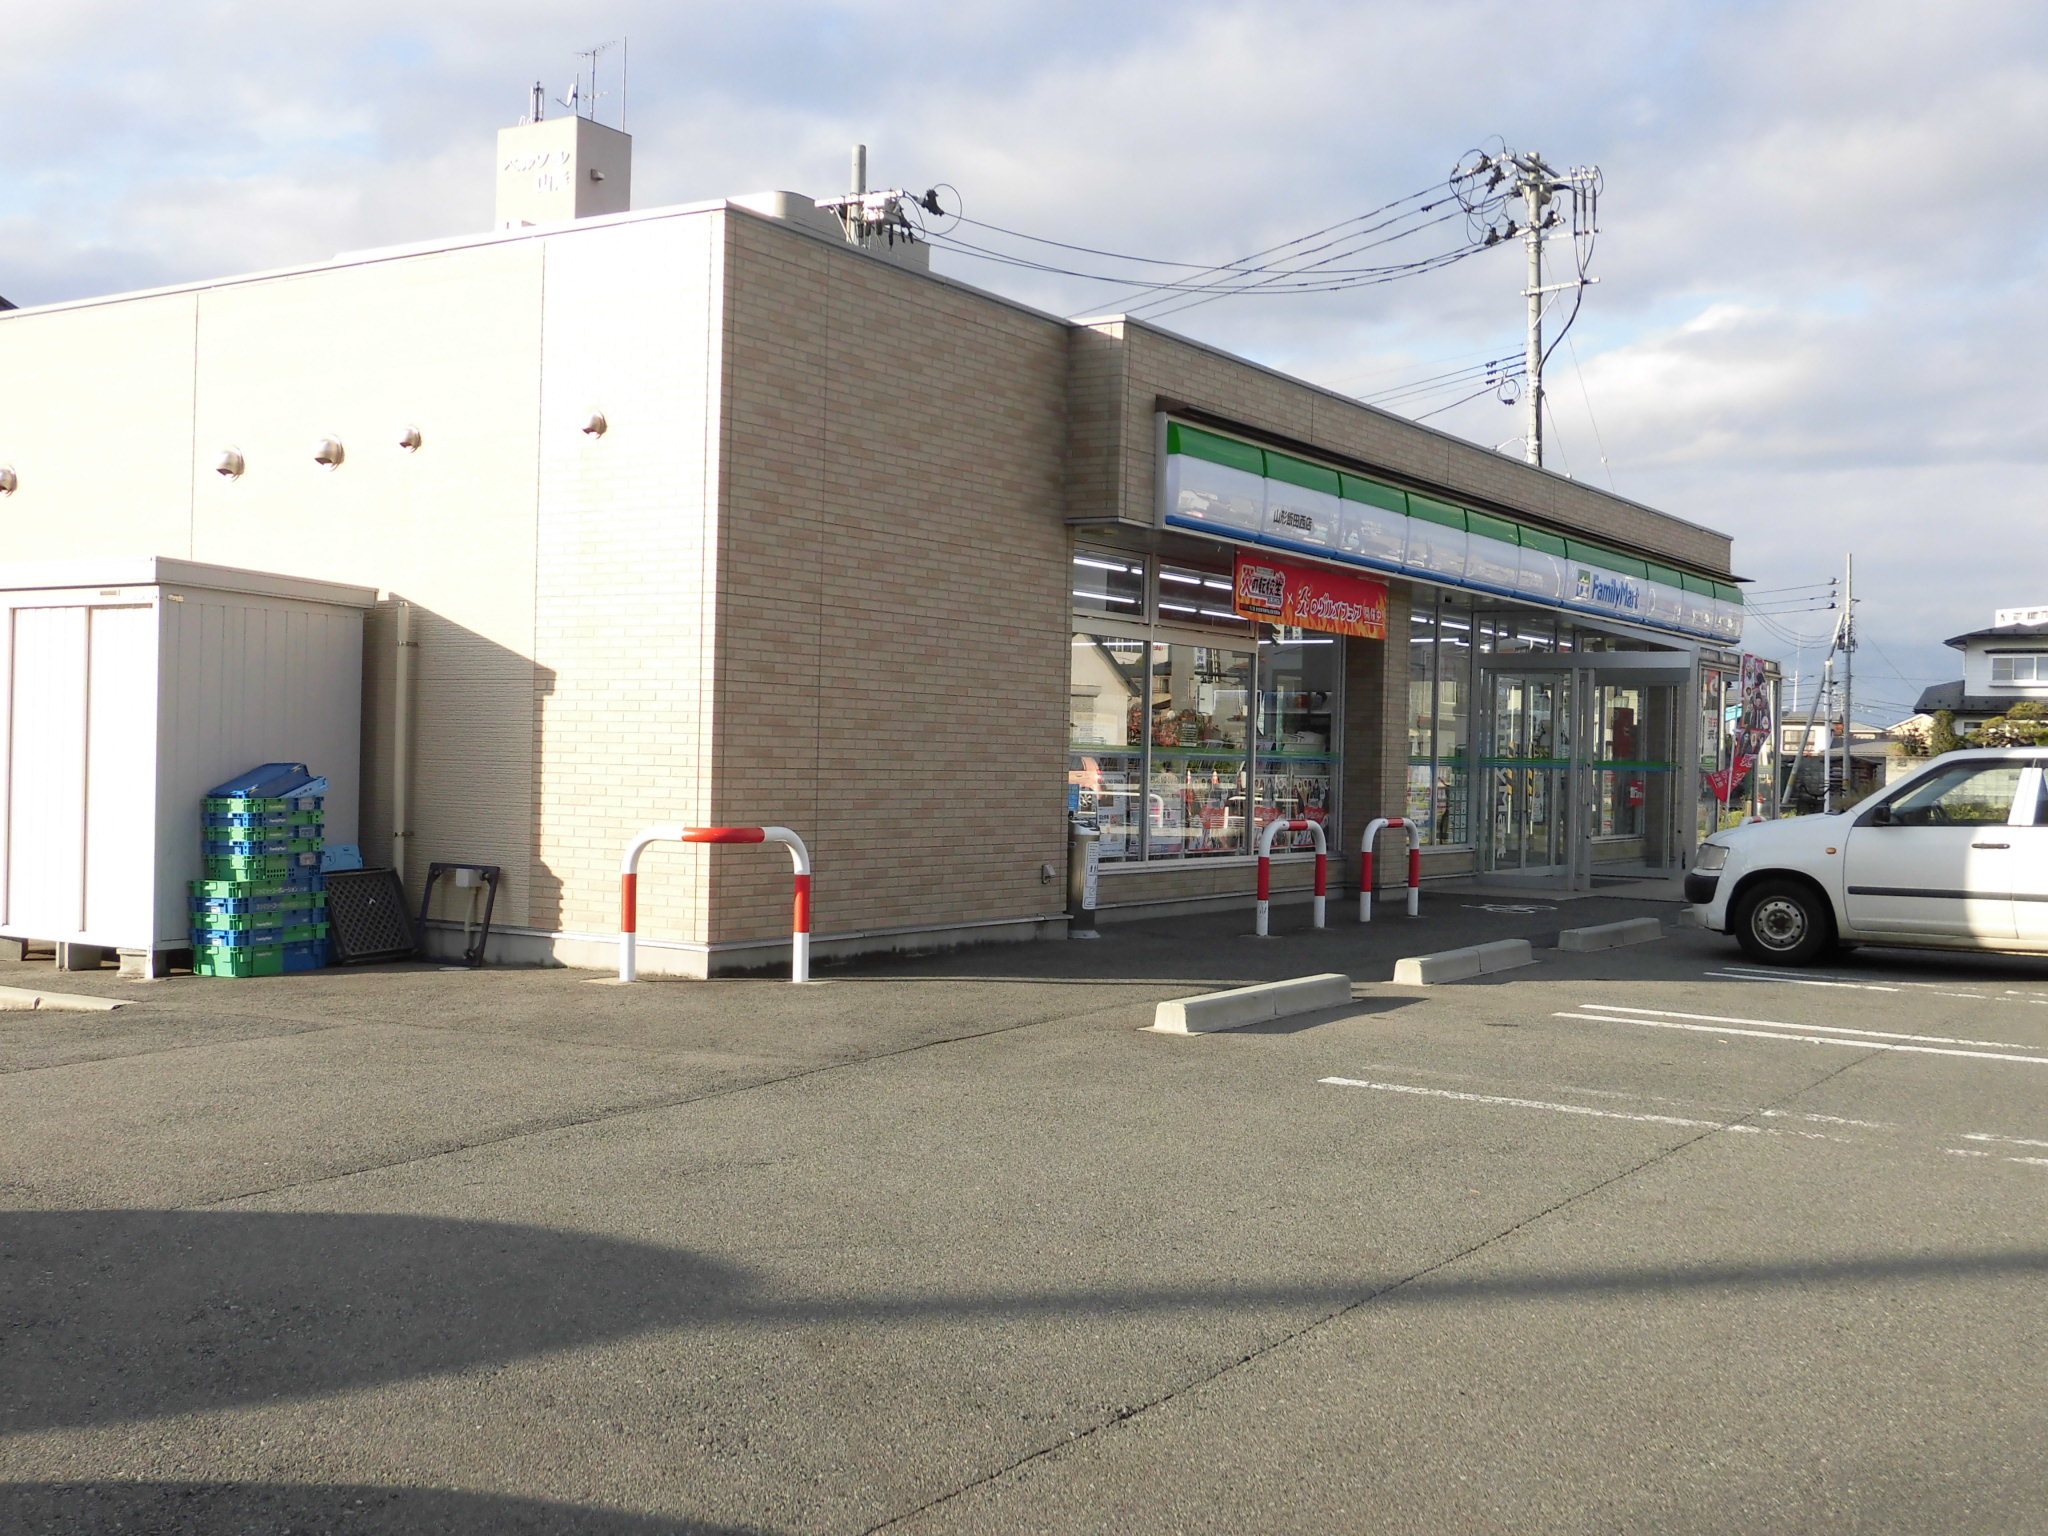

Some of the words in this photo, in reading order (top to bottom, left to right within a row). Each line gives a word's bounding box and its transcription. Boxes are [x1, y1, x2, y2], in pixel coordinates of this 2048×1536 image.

[1295, 585, 1363, 622] 炎のグルメフェア
[1591, 573, 1640, 609] FamilyMart
